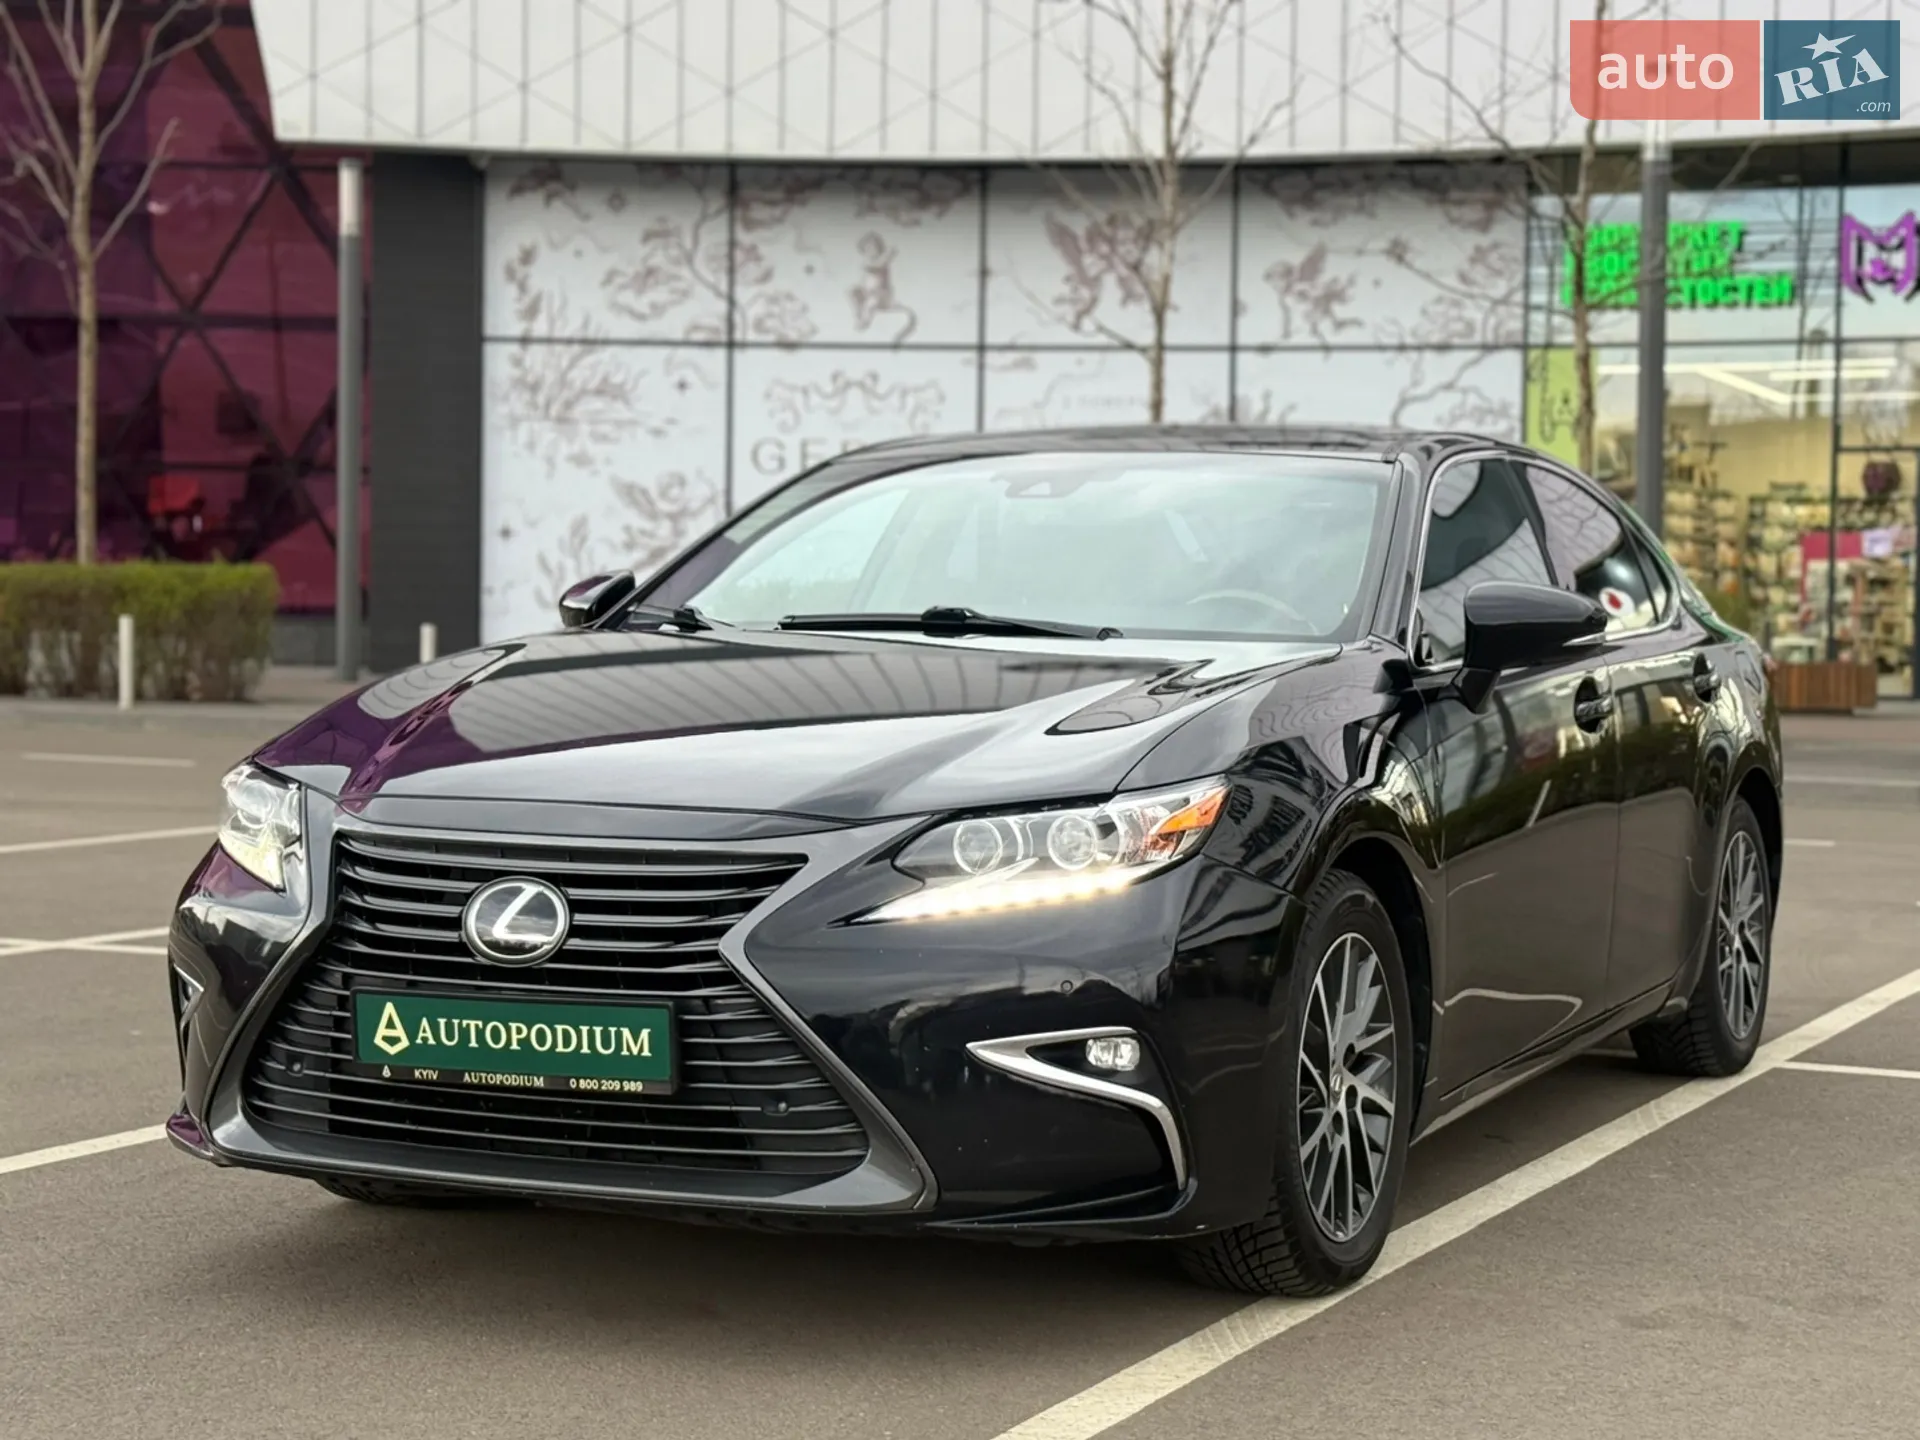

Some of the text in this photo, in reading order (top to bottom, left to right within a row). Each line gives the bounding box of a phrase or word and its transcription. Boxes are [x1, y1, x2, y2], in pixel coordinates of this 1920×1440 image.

[415, 1016, 652, 1057] AUTOPODIUM
[414, 1068, 643, 1092] KYIV AUTOPODIUM 0 800 209 989
